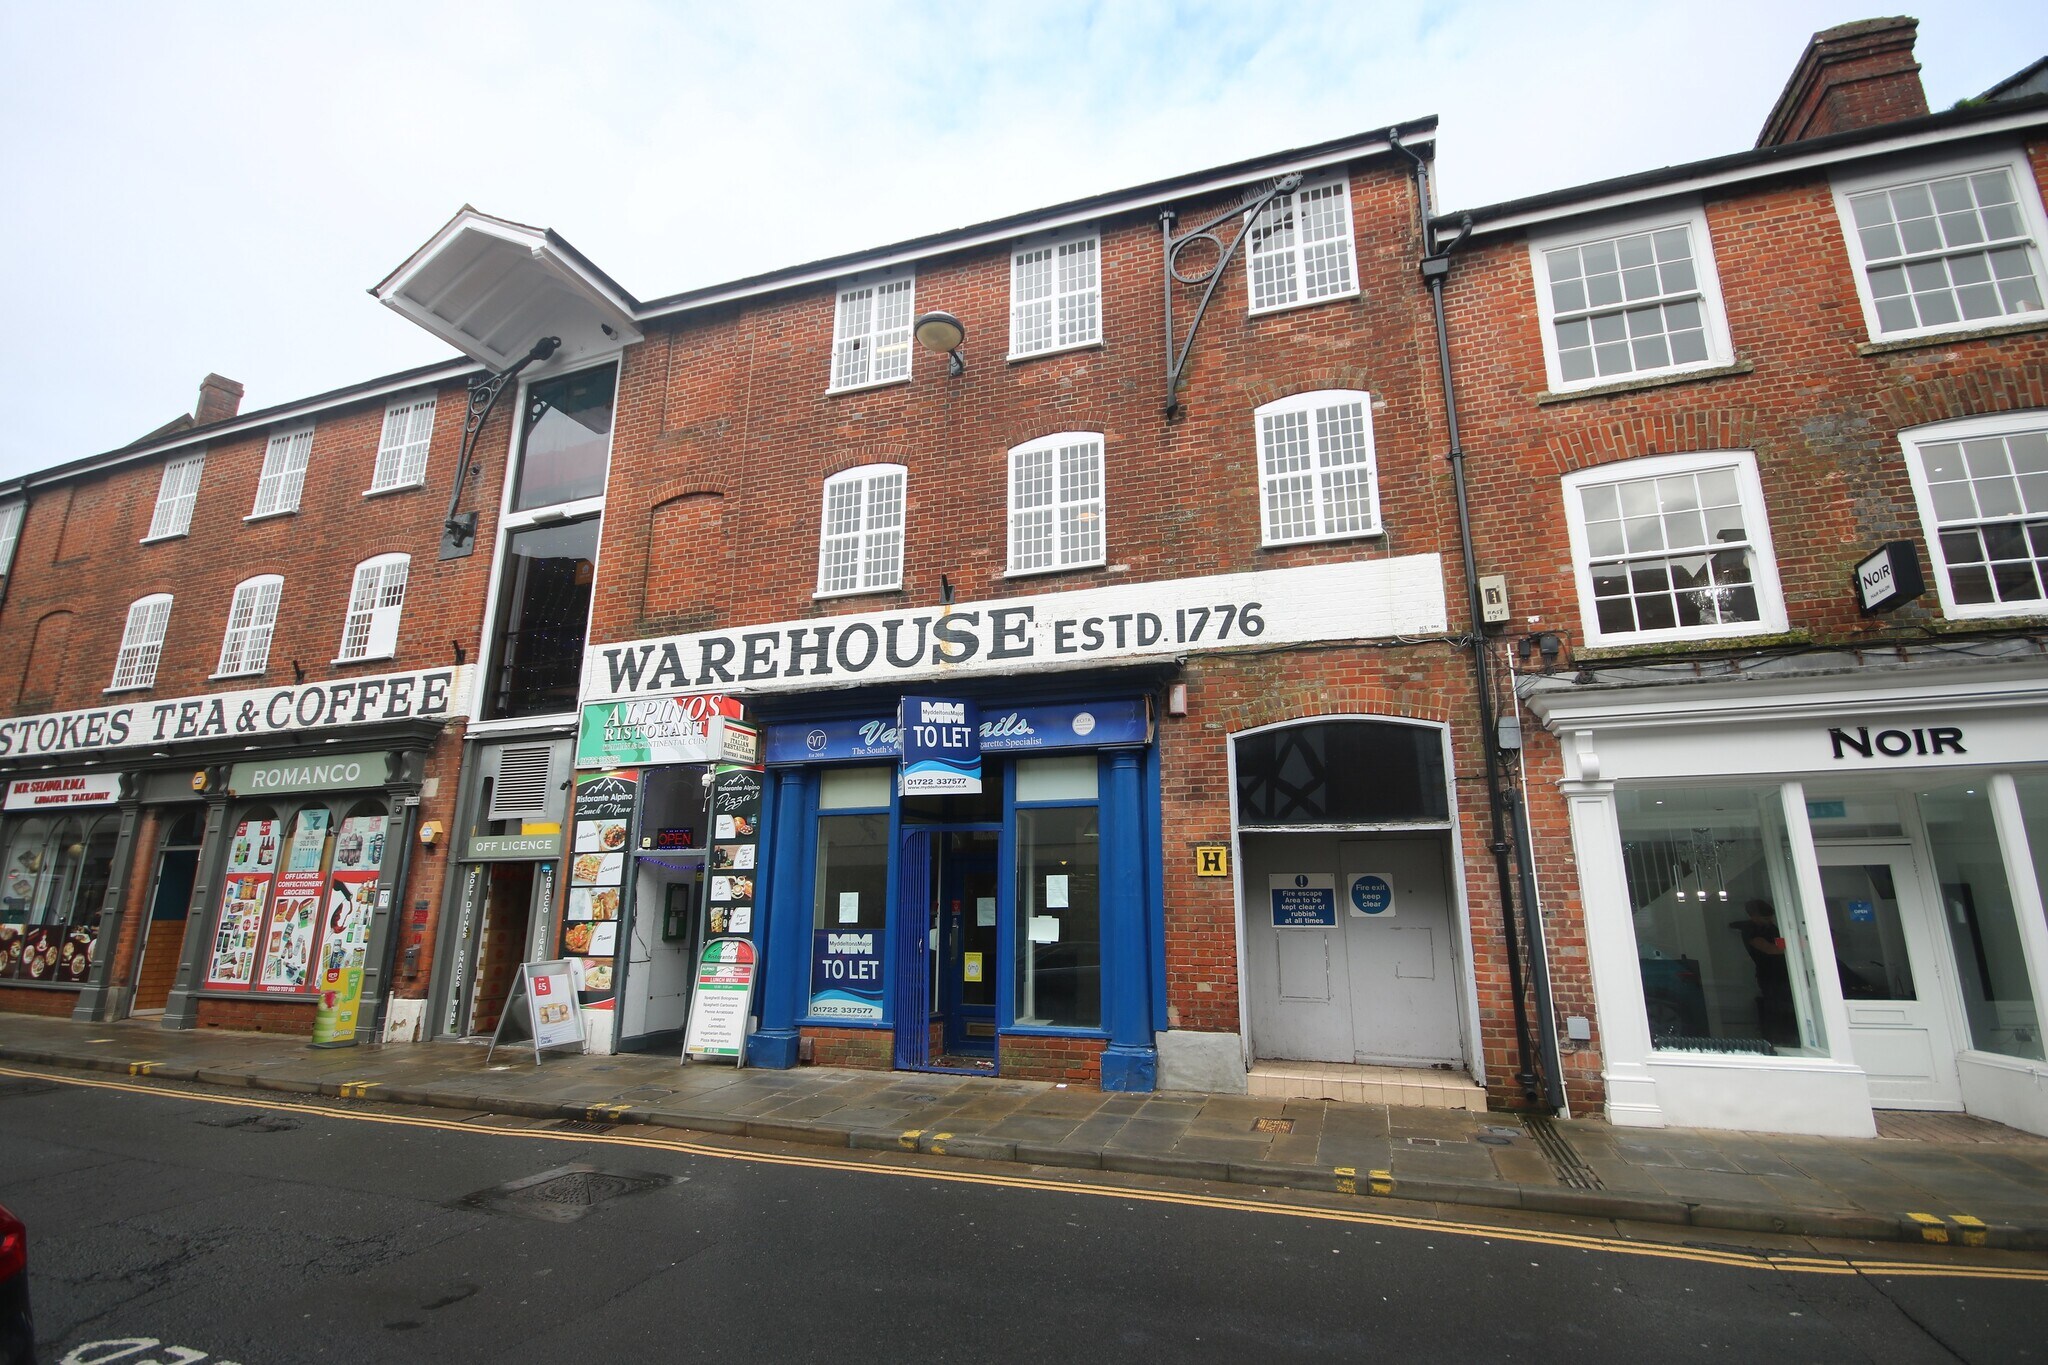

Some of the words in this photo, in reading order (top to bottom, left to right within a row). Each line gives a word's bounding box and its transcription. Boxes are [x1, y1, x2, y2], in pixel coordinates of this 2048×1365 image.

[1863, 564, 1890, 590] NOIR
[603, 606, 1034, 693] WAREHOUSE
[1054, 613, 1168, 654] ESTD.
[1176, 602, 1265, 643] 1776
[0, 708, 134, 755] STOKES
[152, 699, 227, 740] TEA
[235, 700, 260, 732] &
[266, 672, 452, 729] COFFEE
[603, 694, 722, 728] ALPINOS
[604, 720, 706, 742] RISTORANT
[913, 726, 937, 748] TO
[942, 726, 971, 748] LET
[723, 742, 755, 754] RESTAURANT
[852, 747, 865, 755] The
[866, 745, 893, 754] South's
[1005, 737, 1042, 748] Specialist
[1828, 727, 1967, 759] NOIR
[252, 763, 361, 788] ROMANCO
[907, 778, 933, 786] 01722
[13, 782, 30, 794] MR
[30, 778, 86, 792] SHAWARMA
[71, 792, 111, 802] TAKEAWAY
[576, 795, 609, 803] Ristorante
[610, 793, 633, 802] Alpino
[716, 791, 761, 812] Pizza's
[575, 804, 601, 816] Lunch
[603, 803, 632, 815] Menu
[476, 842, 498, 852] OFF
[501, 840, 552, 851] LICENCE
[658, 833, 691, 845] OPEN
[1202, 852, 1221, 871] H
[468, 872, 476, 896] SOFT
[542, 870, 553, 914] TOBACCO
[380, 893, 389, 904] 70
[1362, 894, 1381, 902] keep
[1362, 900, 1381, 908] clear
[462, 901, 472, 939] DRINKS
[455, 950, 465, 987] SNACKS
[822, 960, 844, 979] TO
[849, 960, 879, 980] LET
[538, 982, 547, 991] £5
[450, 999, 460, 1025] WINE
